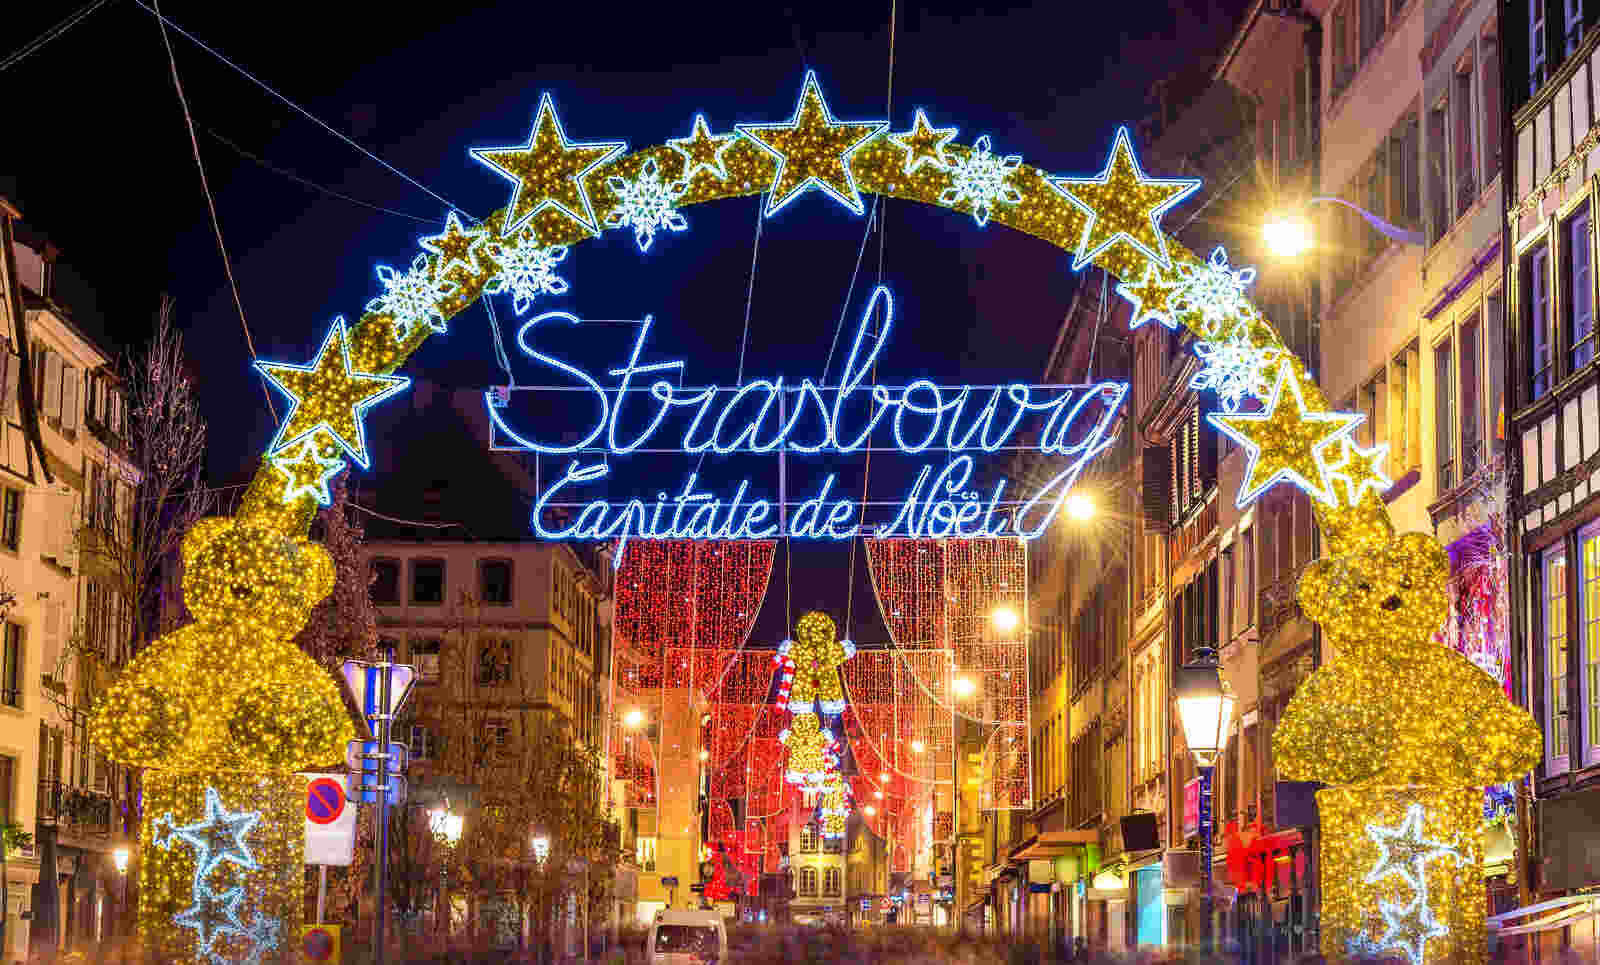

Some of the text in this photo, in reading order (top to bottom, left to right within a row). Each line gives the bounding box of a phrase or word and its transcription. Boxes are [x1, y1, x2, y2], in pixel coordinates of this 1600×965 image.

[486, 286, 1130, 539] Strasbourg
[534, 455, 1008, 568] Capitale de Noël
